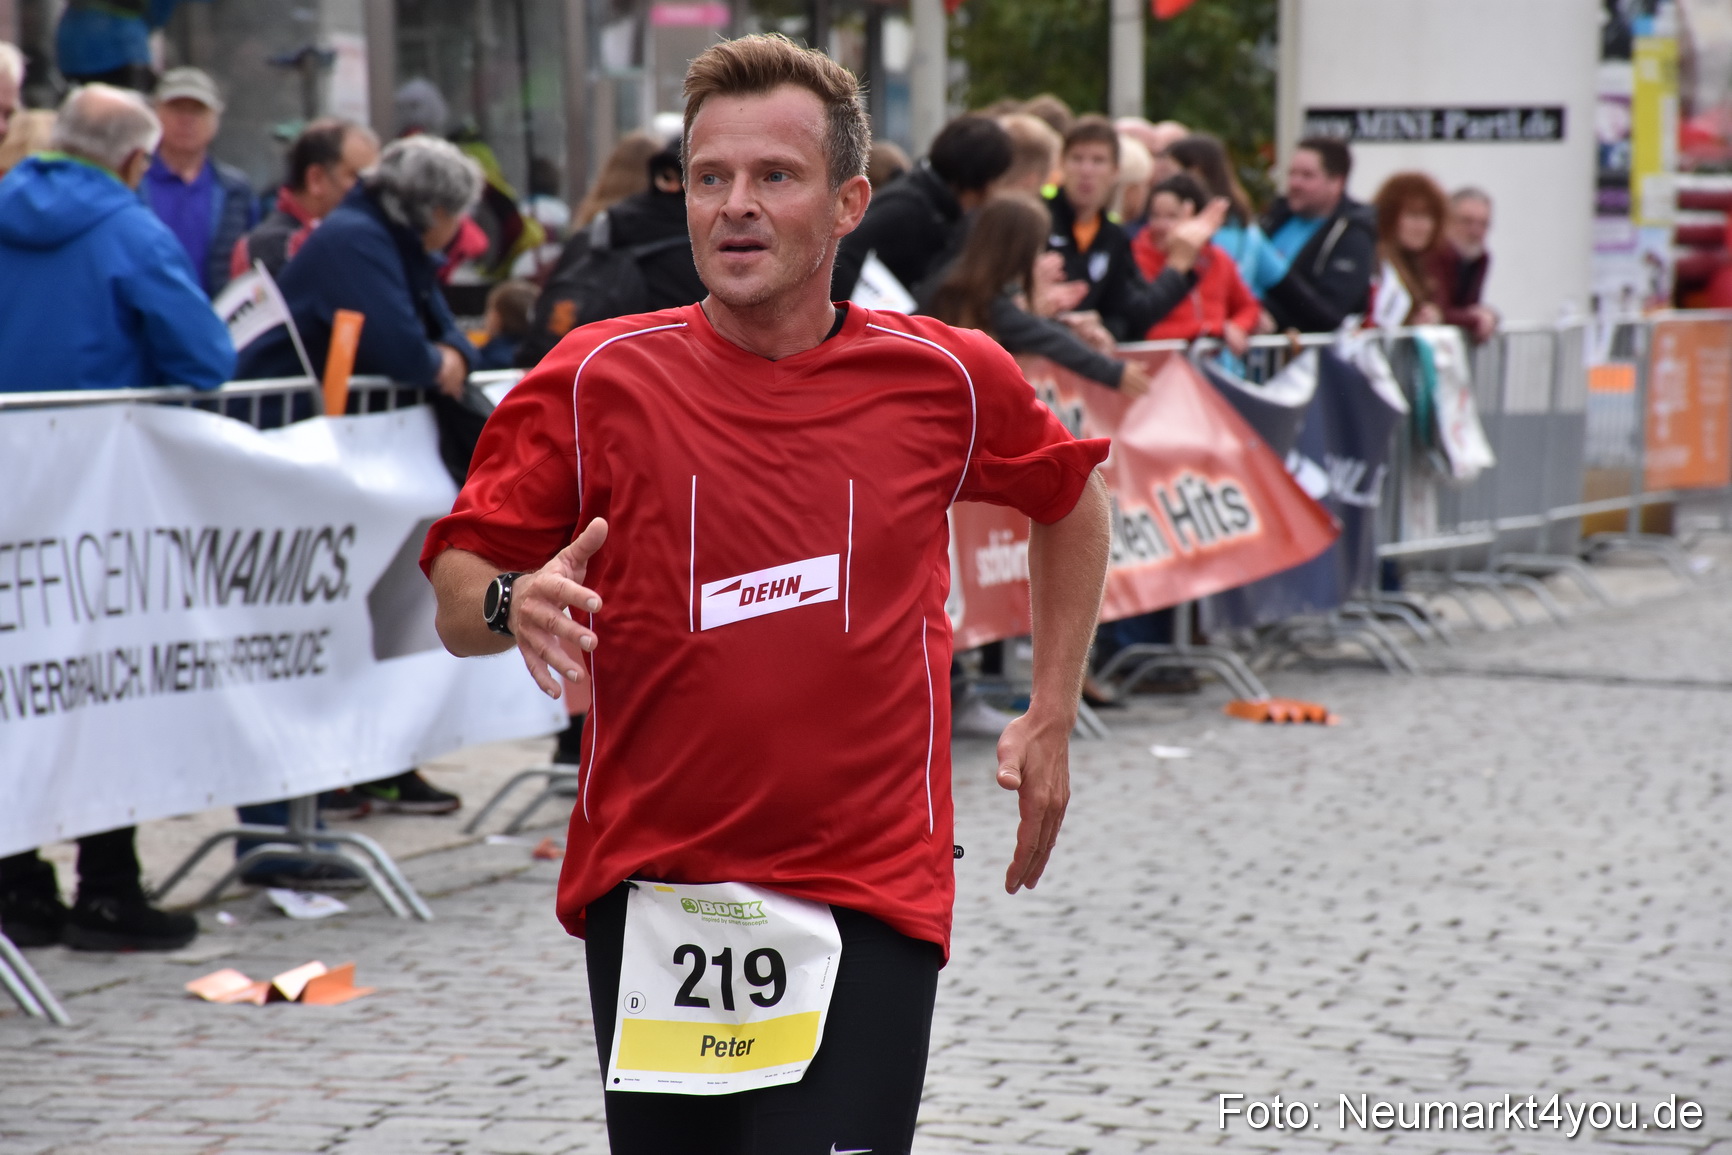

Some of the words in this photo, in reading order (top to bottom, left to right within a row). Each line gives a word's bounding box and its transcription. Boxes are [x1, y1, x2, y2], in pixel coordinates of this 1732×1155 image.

[1156, 473, 1250, 548] Hits
[738, 574, 802, 607] DEHN
[698, 900, 766, 919] BOCK
[701, 915, 720, 924] inspired
[742, 918, 769, 927] concepts
[673, 943, 787, 1011] 219
[630, 997, 639, 1009] D
[700, 1035, 755, 1058] Peter
